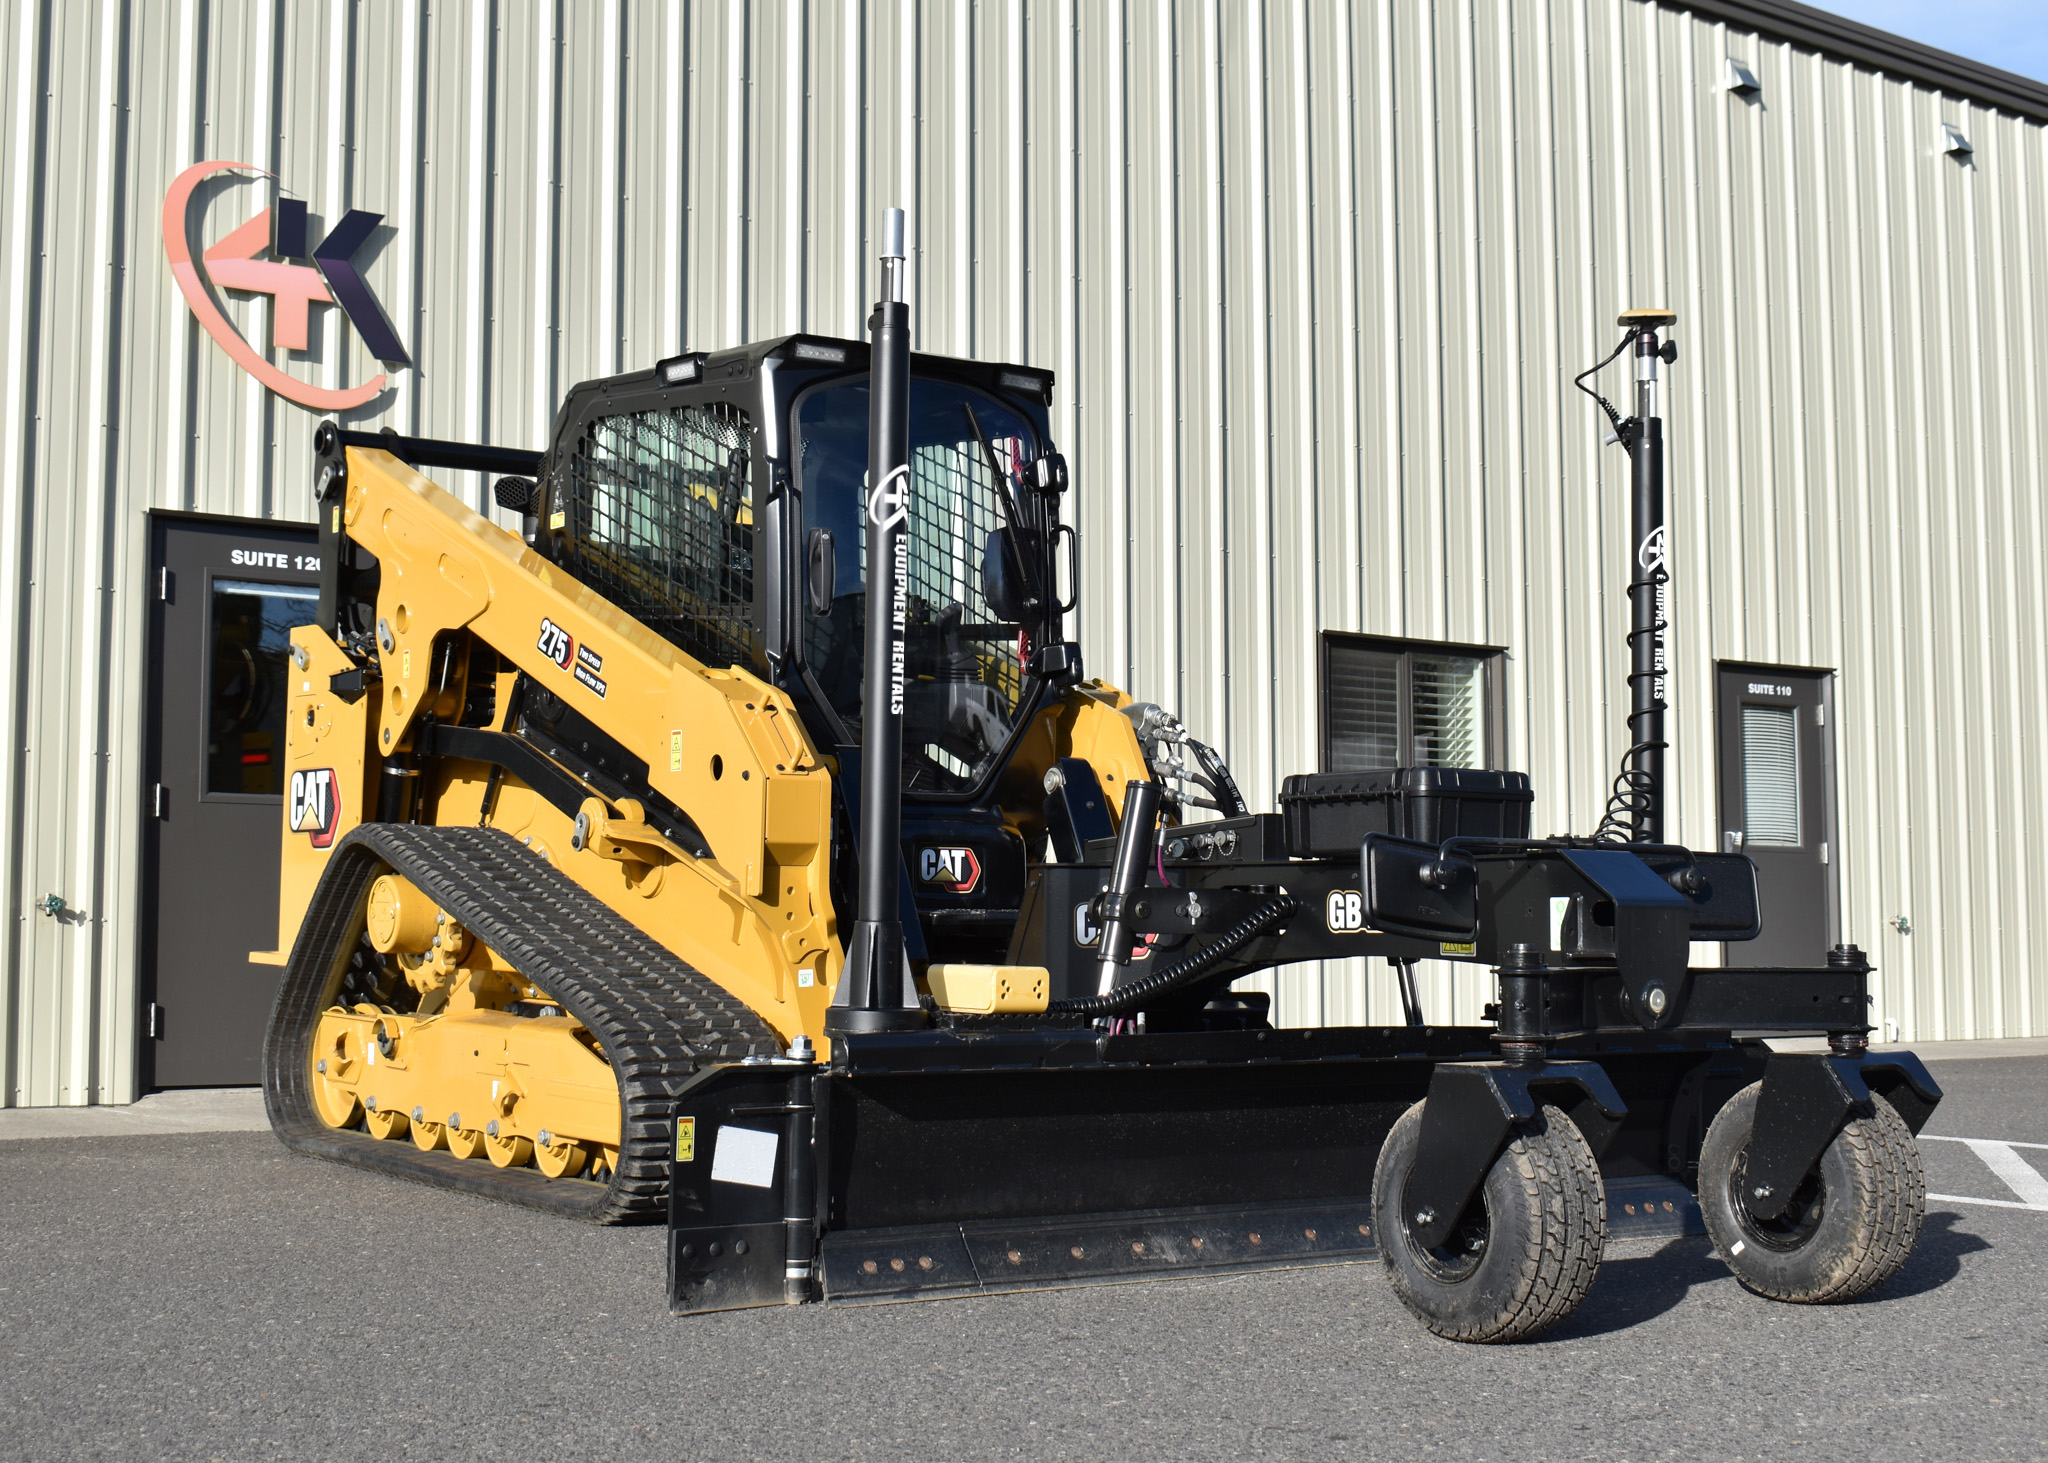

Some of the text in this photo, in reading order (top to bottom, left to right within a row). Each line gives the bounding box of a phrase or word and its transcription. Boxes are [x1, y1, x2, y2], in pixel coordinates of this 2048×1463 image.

[230, 549, 289, 569] SUITE
[537, 618, 566, 664] 275
[891, 533, 907, 715] EQUIPMENT RENTALS
[1654, 647, 1664, 700] RENALS
[1748, 683, 1792, 696] SUITE 110
[290, 770, 330, 831] CAT
[921, 848, 966, 882] CAT
